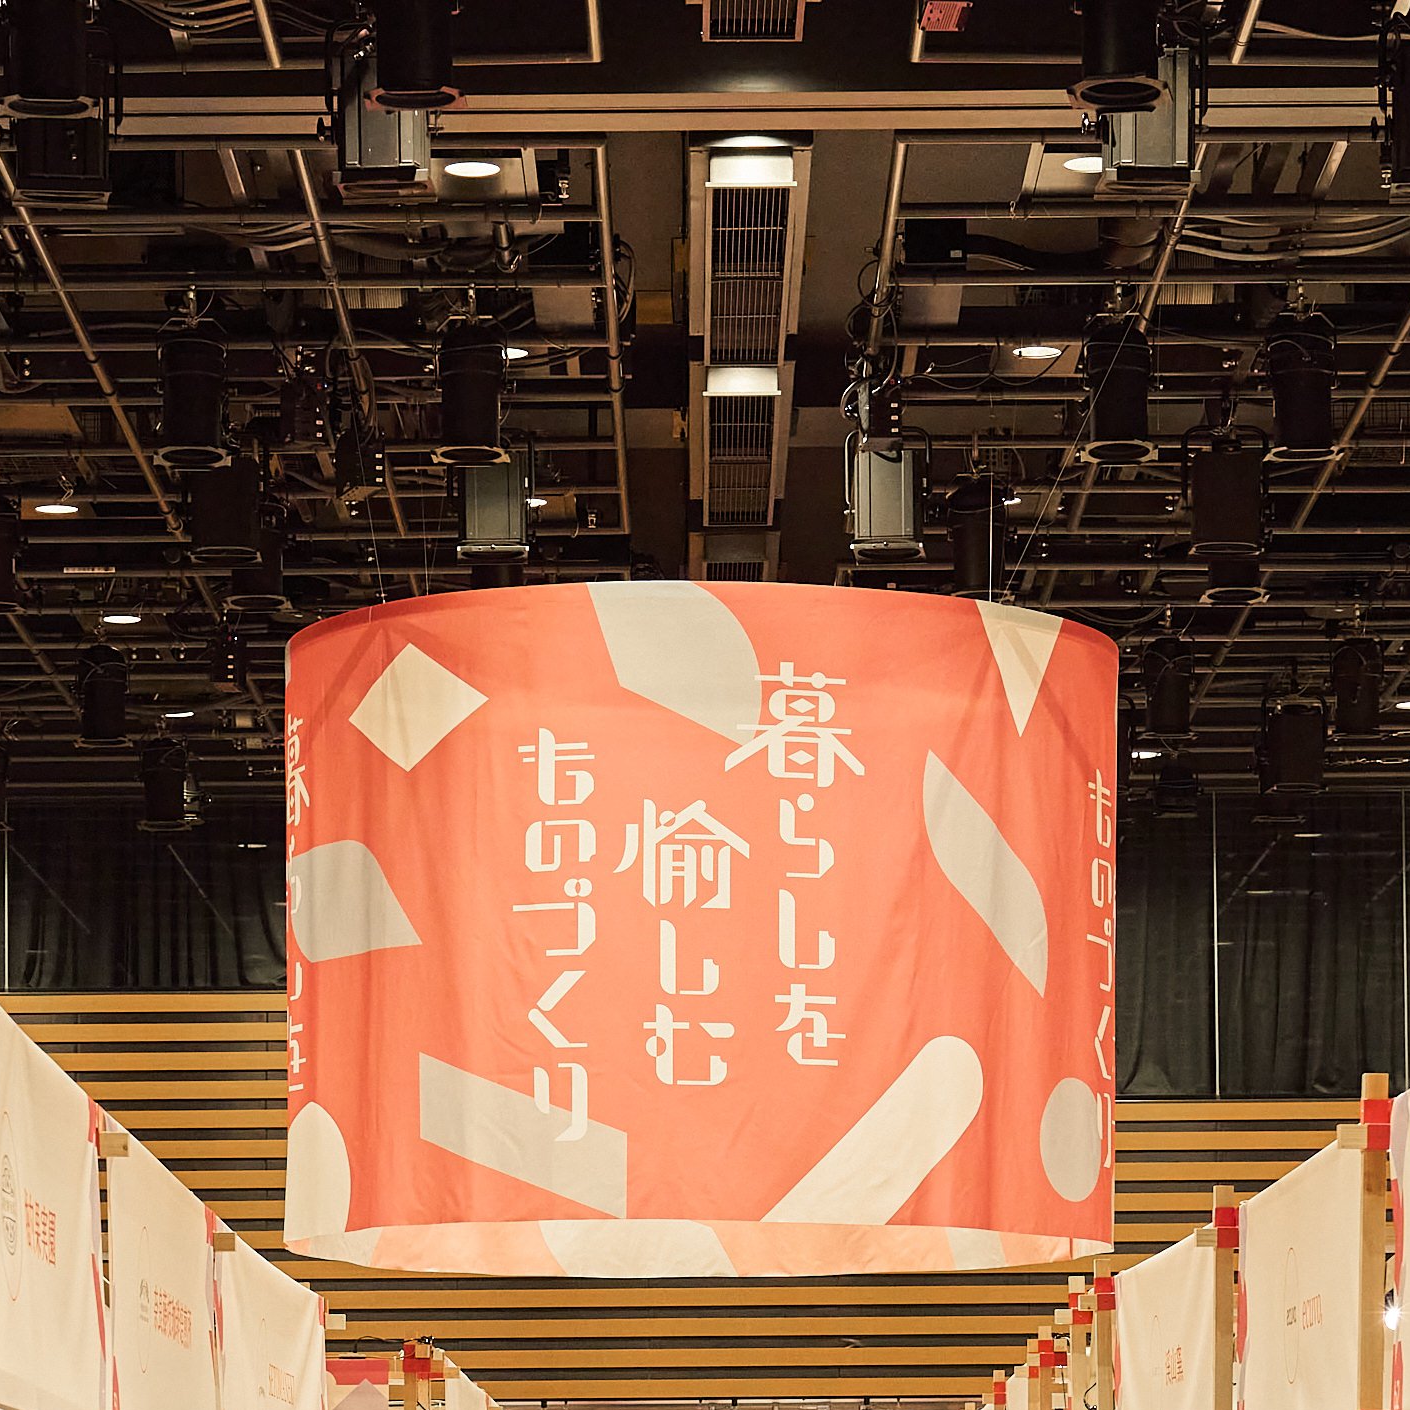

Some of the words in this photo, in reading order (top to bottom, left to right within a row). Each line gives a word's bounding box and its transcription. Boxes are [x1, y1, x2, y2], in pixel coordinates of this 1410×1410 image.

[512, 726, 600, 1143] ものづくり
[613, 797, 751, 1088] 愉しむ
[724, 660, 866, 1068] 暮らしを
